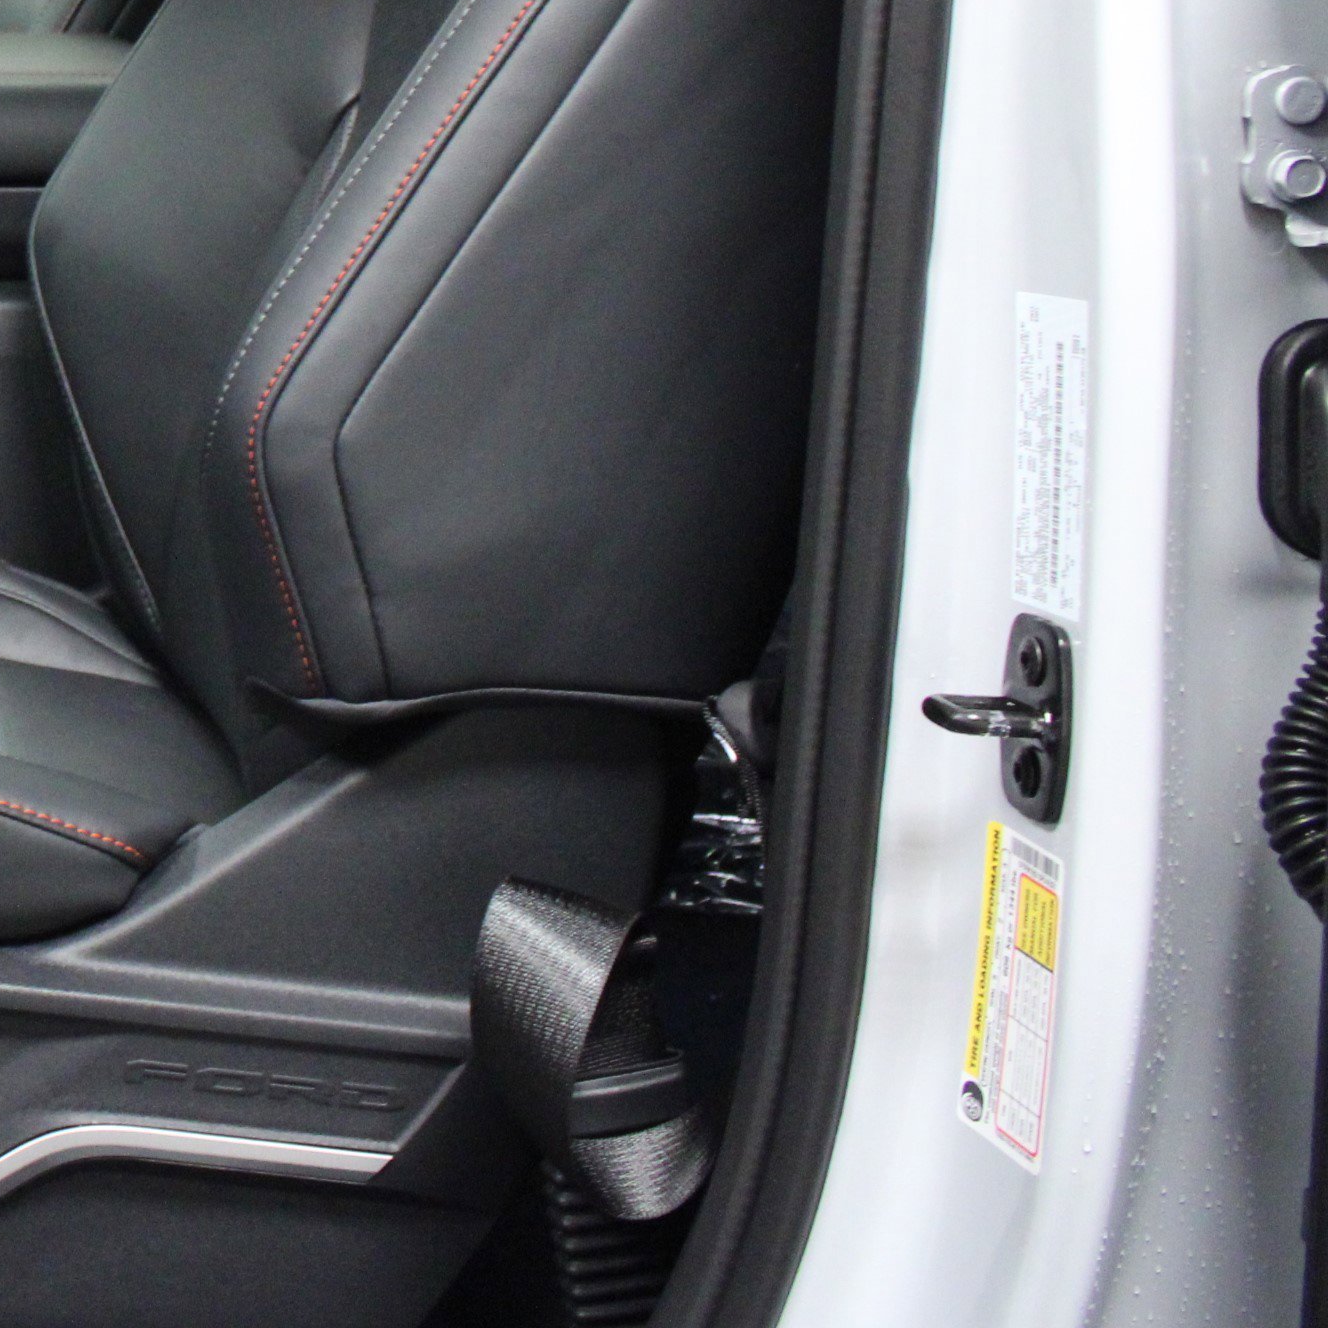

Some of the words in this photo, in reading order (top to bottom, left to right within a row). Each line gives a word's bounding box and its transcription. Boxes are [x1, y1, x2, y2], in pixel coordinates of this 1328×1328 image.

[986, 830, 1000, 930] INFORMATION
[978, 935, 992, 998] LOADING
[974, 1003, 984, 1032] AND
[969, 1037, 980, 1068] TIRE
[123, 1058, 405, 1113] FORD
